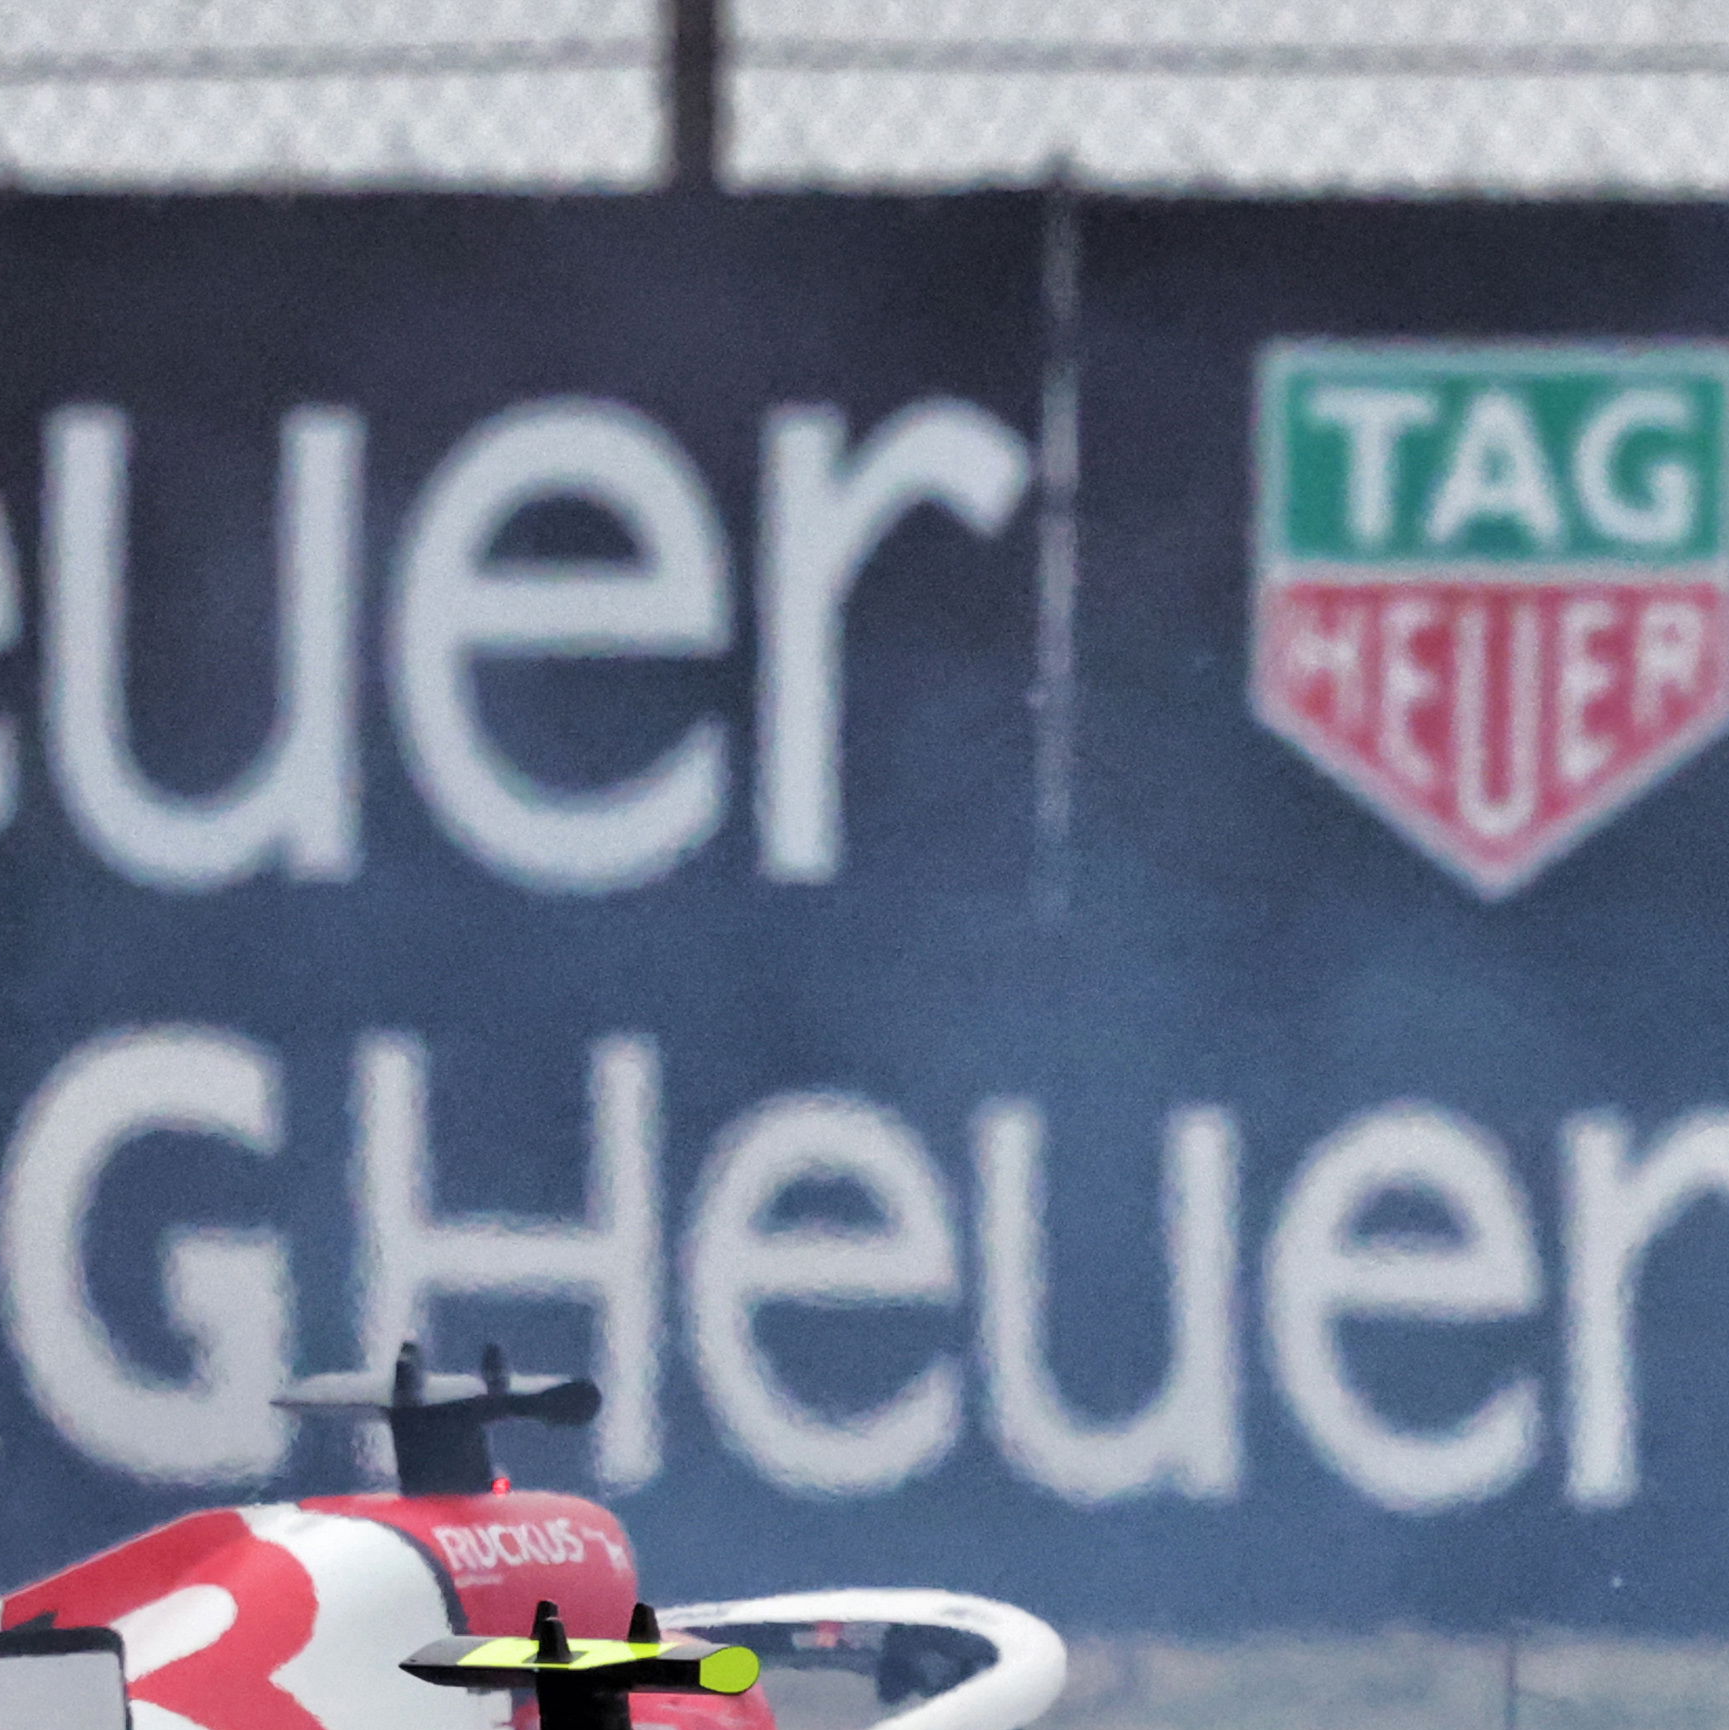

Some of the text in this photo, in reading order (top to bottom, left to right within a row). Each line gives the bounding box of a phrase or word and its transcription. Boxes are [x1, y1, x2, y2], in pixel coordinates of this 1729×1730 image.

[1306, 386, 1702, 548] TAG
[1285, 597, 1708, 838] HEUER
[431, 1517, 586, 1572] RUCKUS
